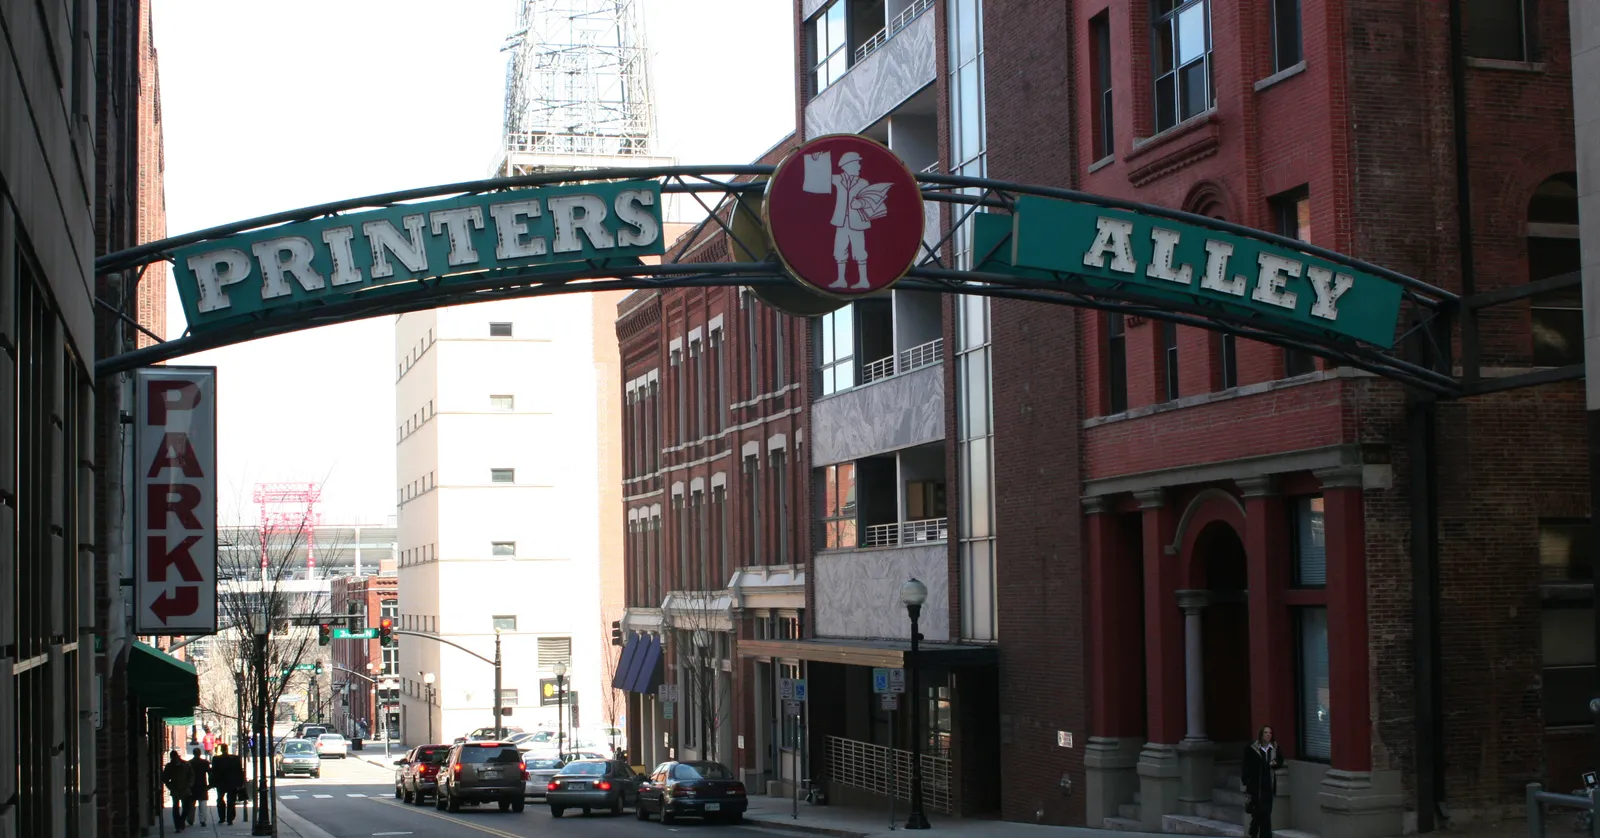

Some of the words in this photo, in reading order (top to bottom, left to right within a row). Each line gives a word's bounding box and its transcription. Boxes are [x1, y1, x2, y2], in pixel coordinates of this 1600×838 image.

[187, 188, 660, 313] PRINTERS
[1083, 215, 1354, 321] ALLEY
[147, 380, 204, 582] PARK
